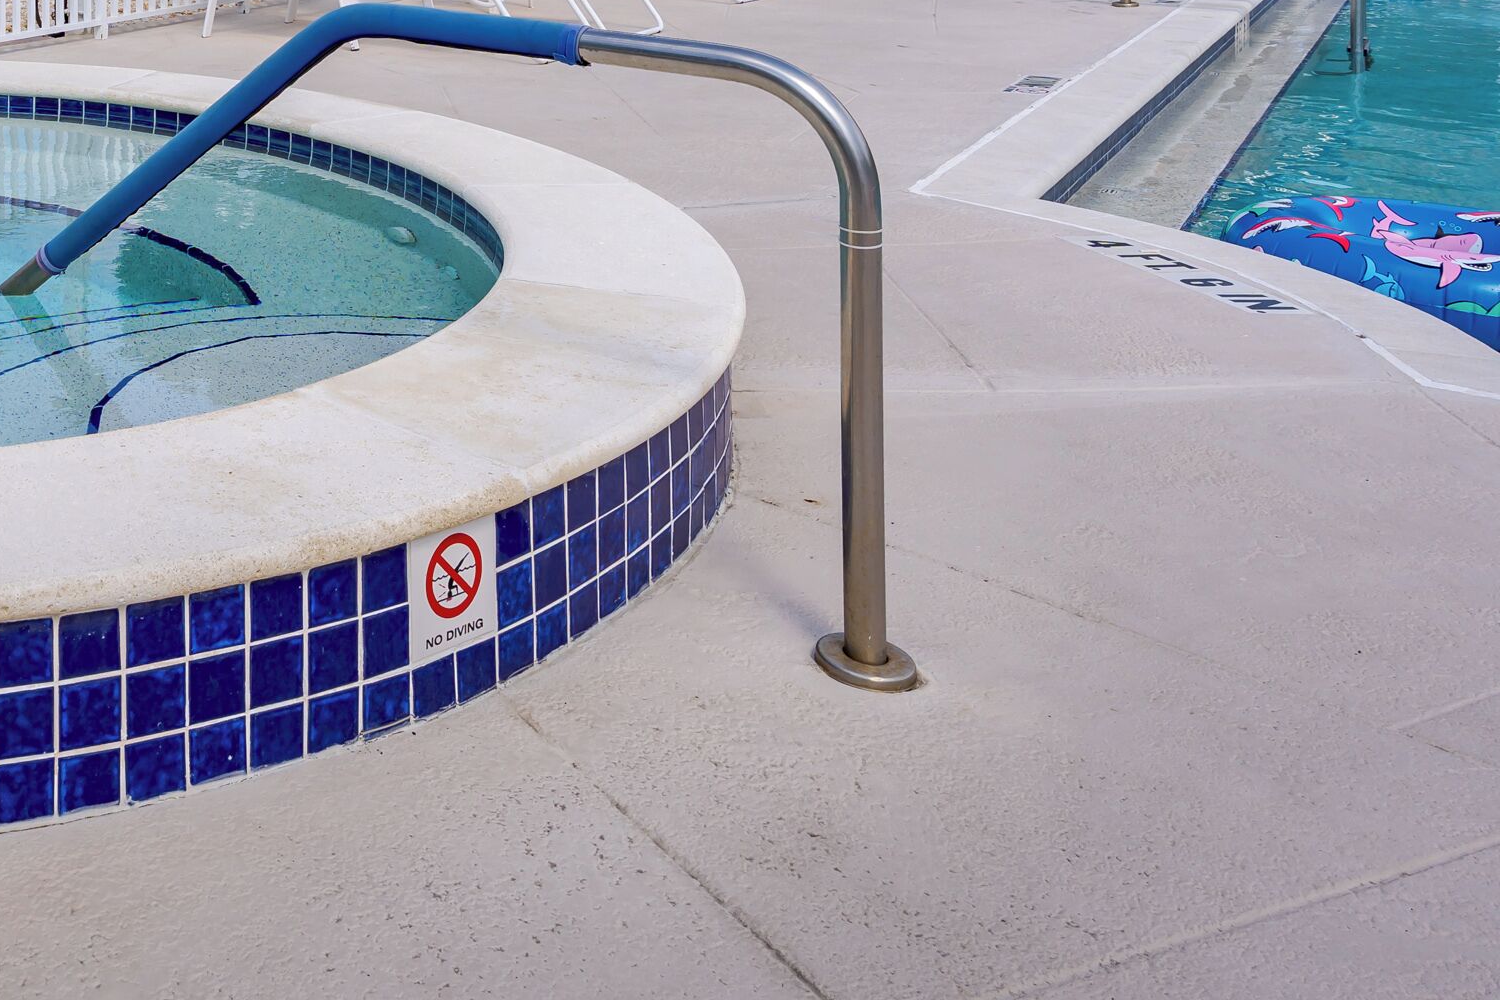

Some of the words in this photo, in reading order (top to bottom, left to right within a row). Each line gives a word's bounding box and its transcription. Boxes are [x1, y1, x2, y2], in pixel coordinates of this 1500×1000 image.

[1087, 240, 1133, 248] 4
[1116, 253, 1199, 271] FT.
[1180, 278, 1234, 287] 6
[1216, 293, 1300, 314] IN.
[426, 634, 443, 650] NO
[446, 618, 484, 642] DIVING
